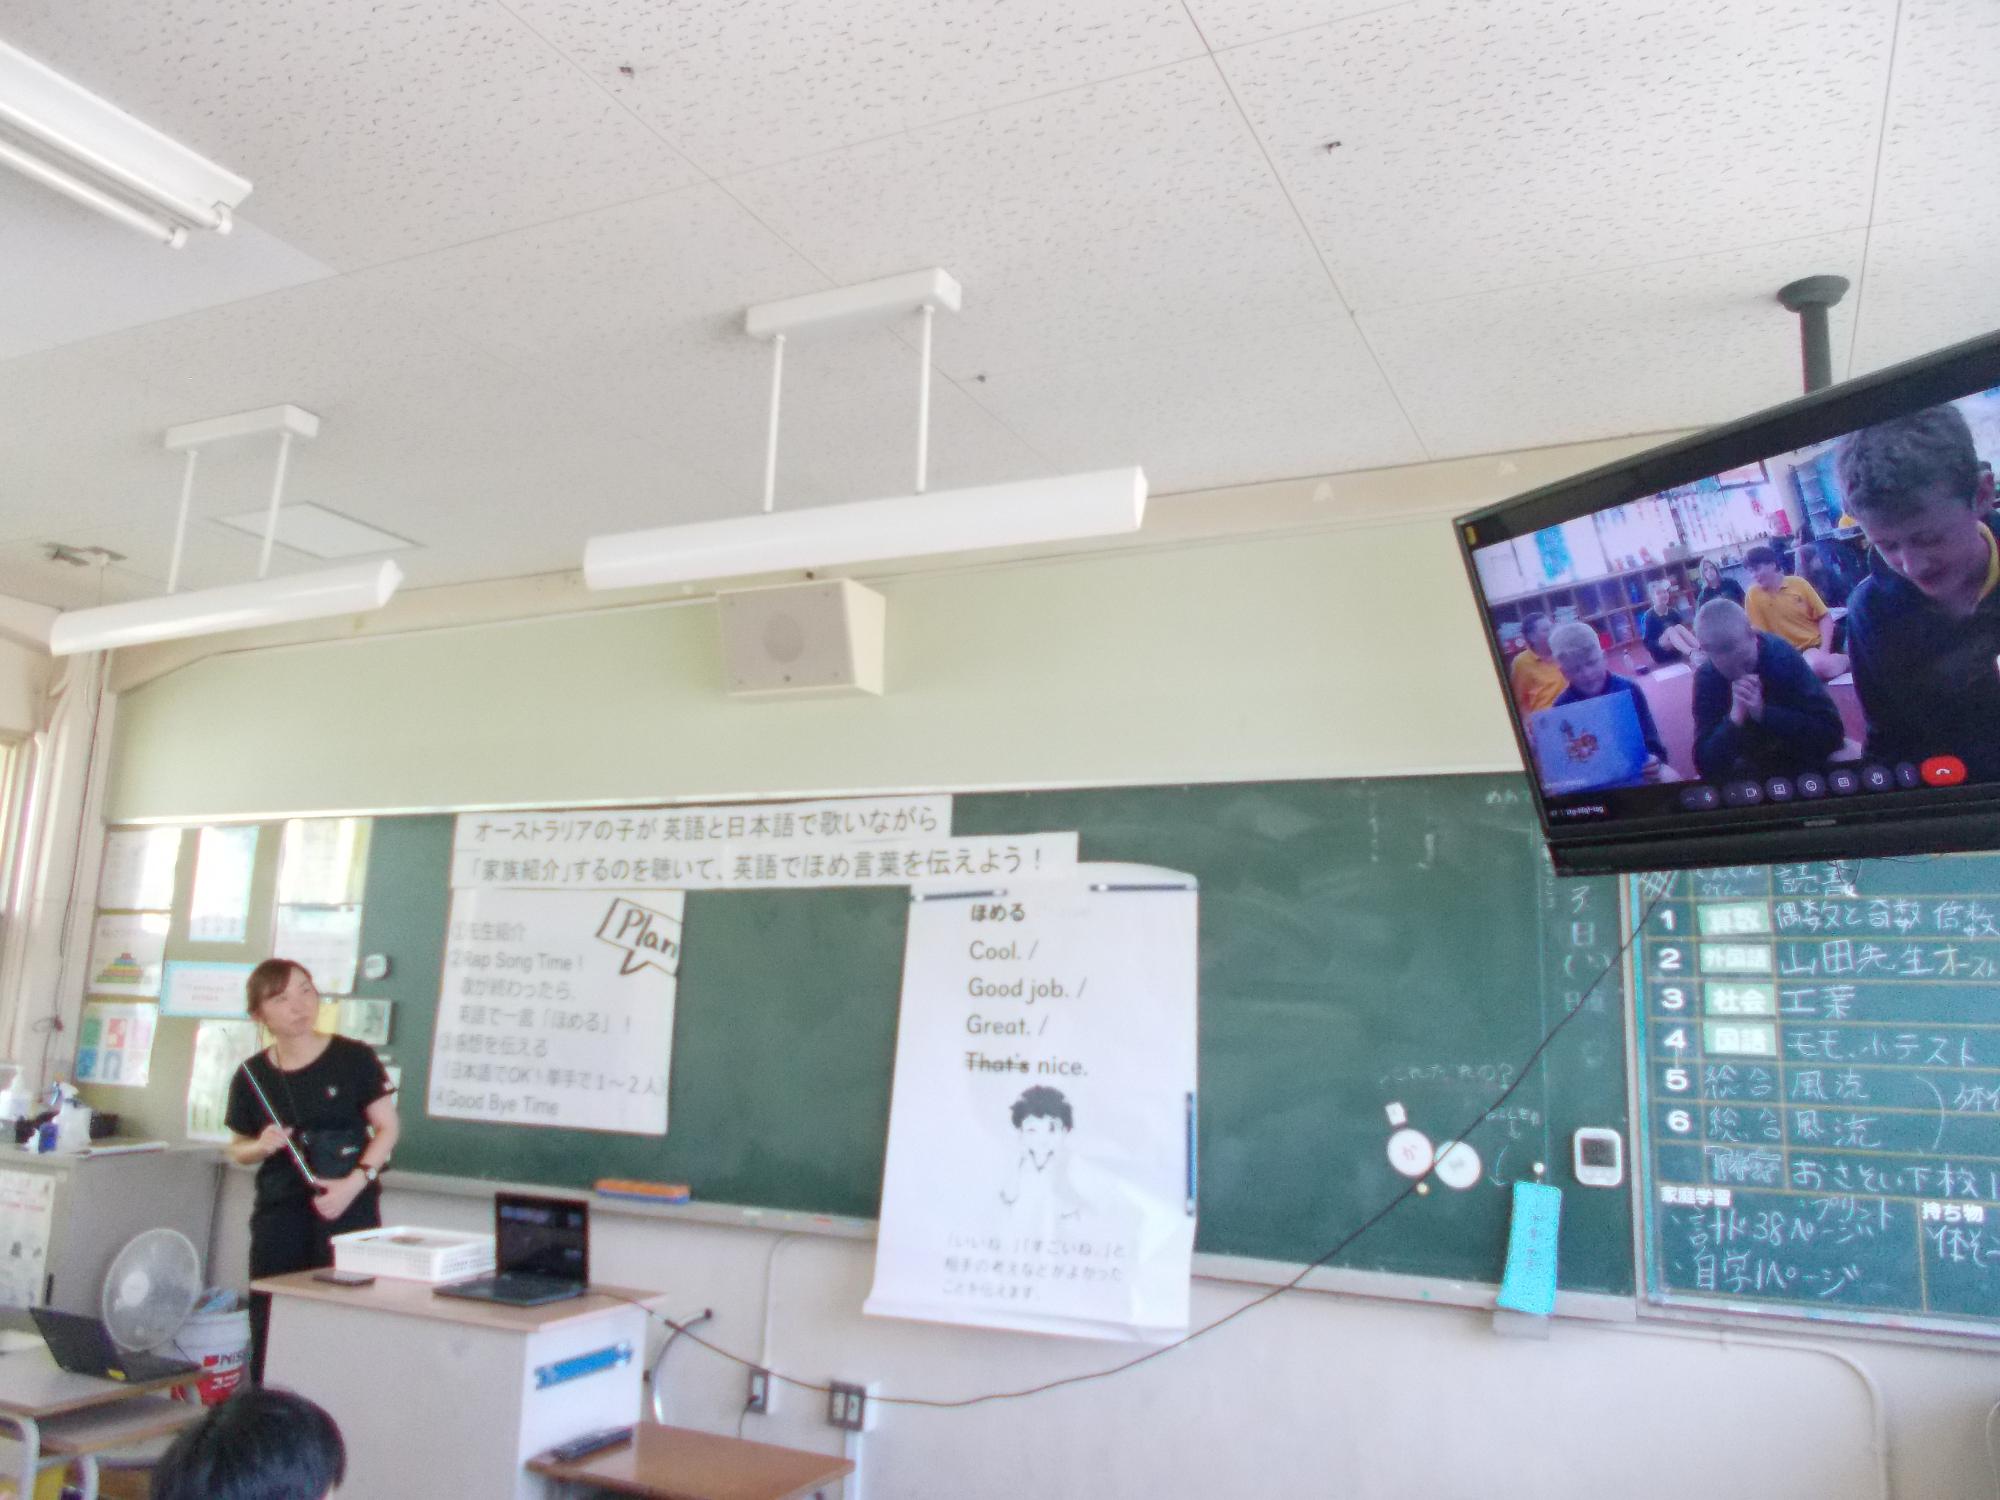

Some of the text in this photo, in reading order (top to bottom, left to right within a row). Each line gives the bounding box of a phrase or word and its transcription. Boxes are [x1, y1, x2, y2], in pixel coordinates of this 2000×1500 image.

[475, 806, 938, 841] オーストラリアの子が英語と日本語で歌いながら
[472, 848, 1041, 881] 「家族紹介」するのを聴いて、英語でほめ言葉を伝えよう！
[970, 903, 1026, 922] ほめる
[1660, 909, 1677, 930] 1
[616, 908, 676, 959] Plan
[495, 951, 533, 973] Song
[969, 940, 1022, 962] Cool.
[1658, 947, 1681, 970] 2
[968, 977, 1022, 998] Good
[1025, 977, 1070, 1005] job.
[1661, 988, 1684, 1009] 3
[1713, 988, 1766, 1013] 社会
[1779, 985, 1856, 1019] 工業
[966, 1014, 1031, 1036] Great.
[1663, 1029, 1688, 1049] 4
[1714, 1027, 1767, 1054] 国語
[1037, 1054, 1089, 1077] nice.
[1664, 1068, 1690, 1091] 5
[488, 1093, 517, 1114] Bye
[523, 1094, 561, 1116] Time
[1667, 1110, 1692, 1133] 6
[1660, 1186, 1732, 1206] 家庭学習
[1921, 1201, 1984, 1223] 持ち物
